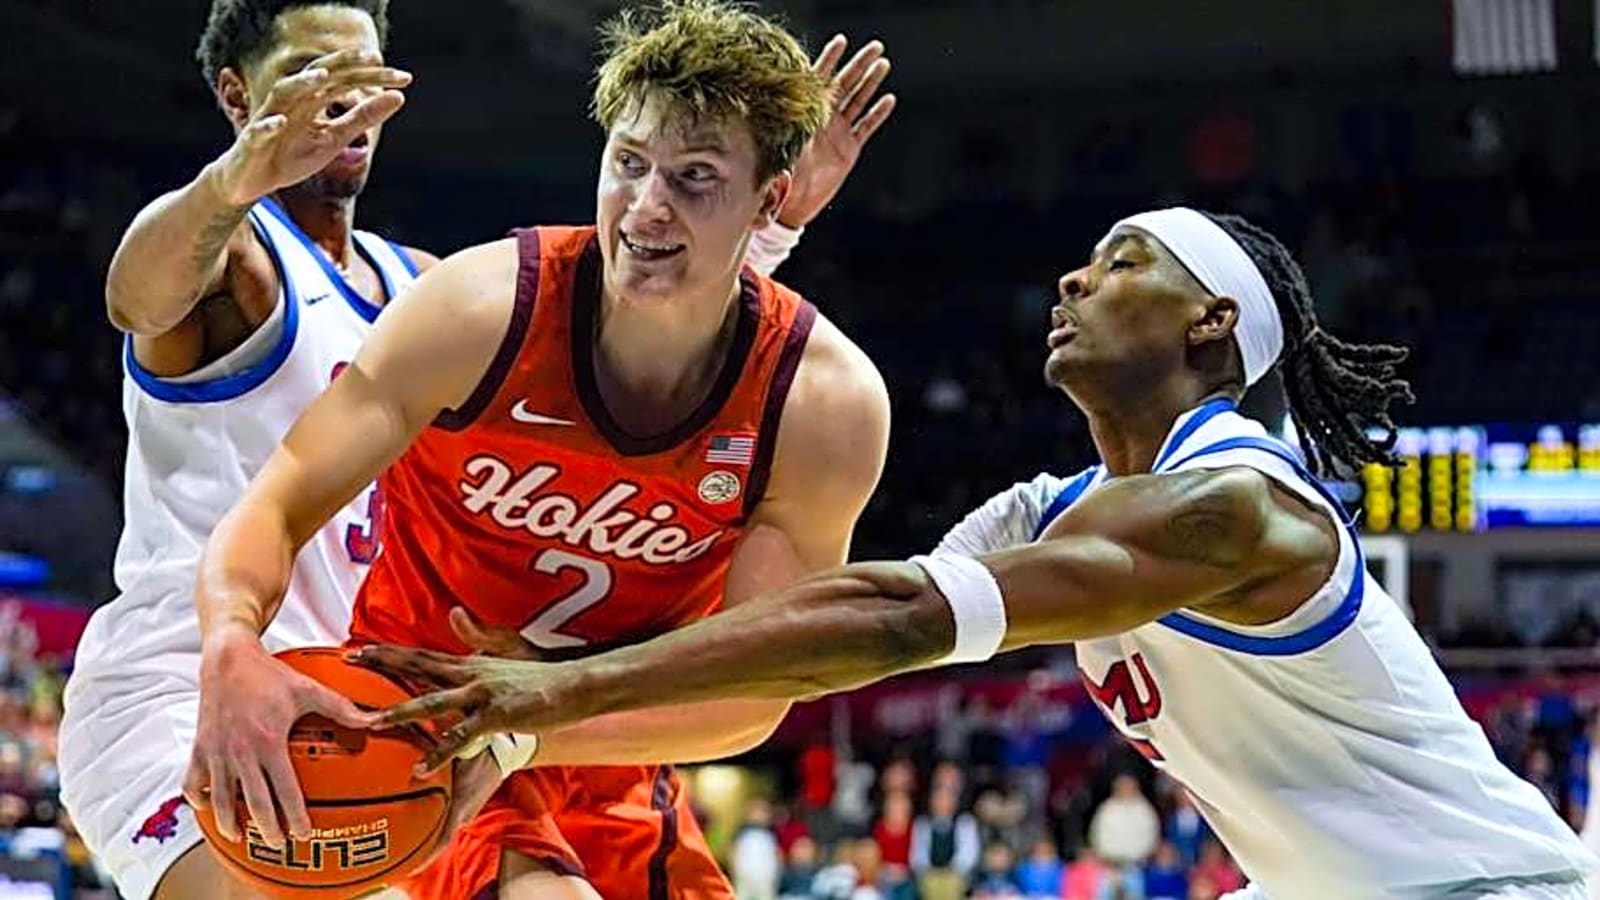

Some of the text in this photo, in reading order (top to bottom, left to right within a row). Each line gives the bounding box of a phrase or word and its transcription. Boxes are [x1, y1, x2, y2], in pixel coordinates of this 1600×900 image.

[459, 455, 723, 565] Hokies
[518, 548, 613, 650] 2
[1080, 651, 1163, 726] MU
[247, 829, 388, 870] ELITE
